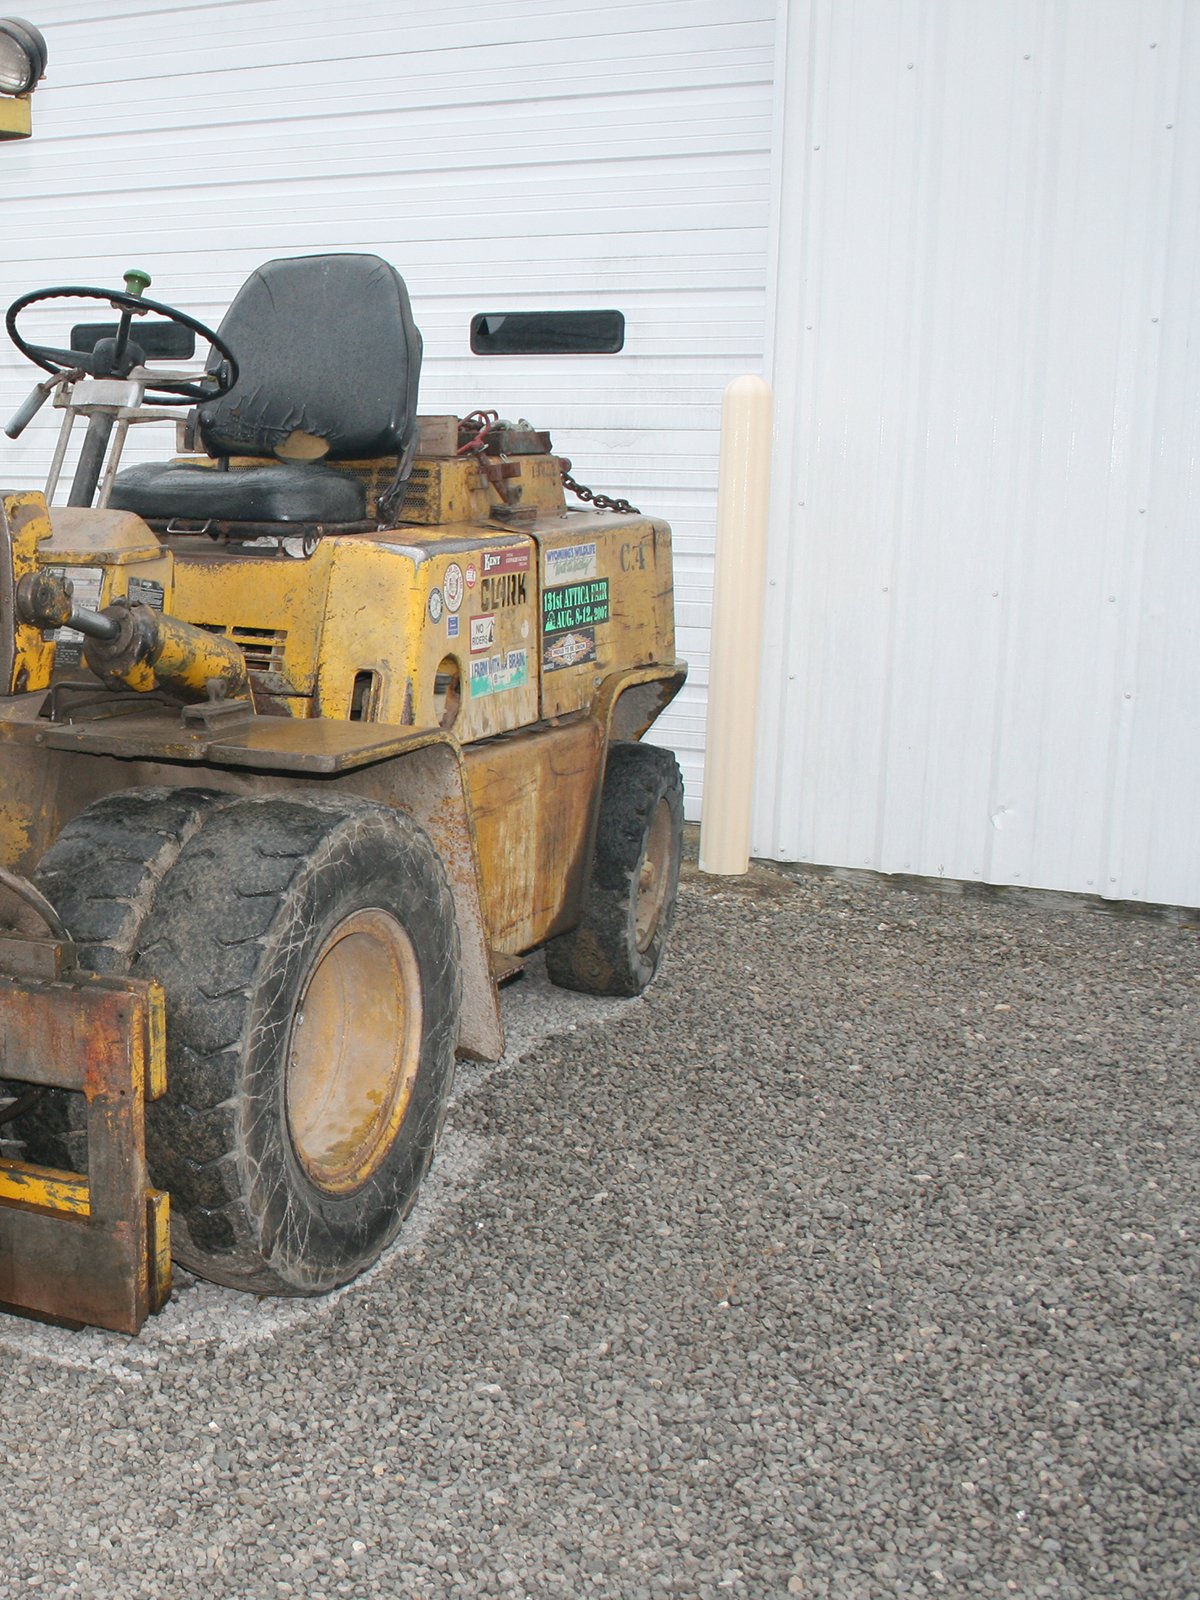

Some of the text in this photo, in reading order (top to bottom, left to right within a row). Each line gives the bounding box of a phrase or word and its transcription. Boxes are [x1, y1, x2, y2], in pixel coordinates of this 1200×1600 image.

[481, 573, 526, 612] CLARK
[544, 582, 608, 612] 131st ATTICA FAIR
[475, 623, 484, 634] NO
[557, 605, 608, 628] AUG. 8-12, 2007
